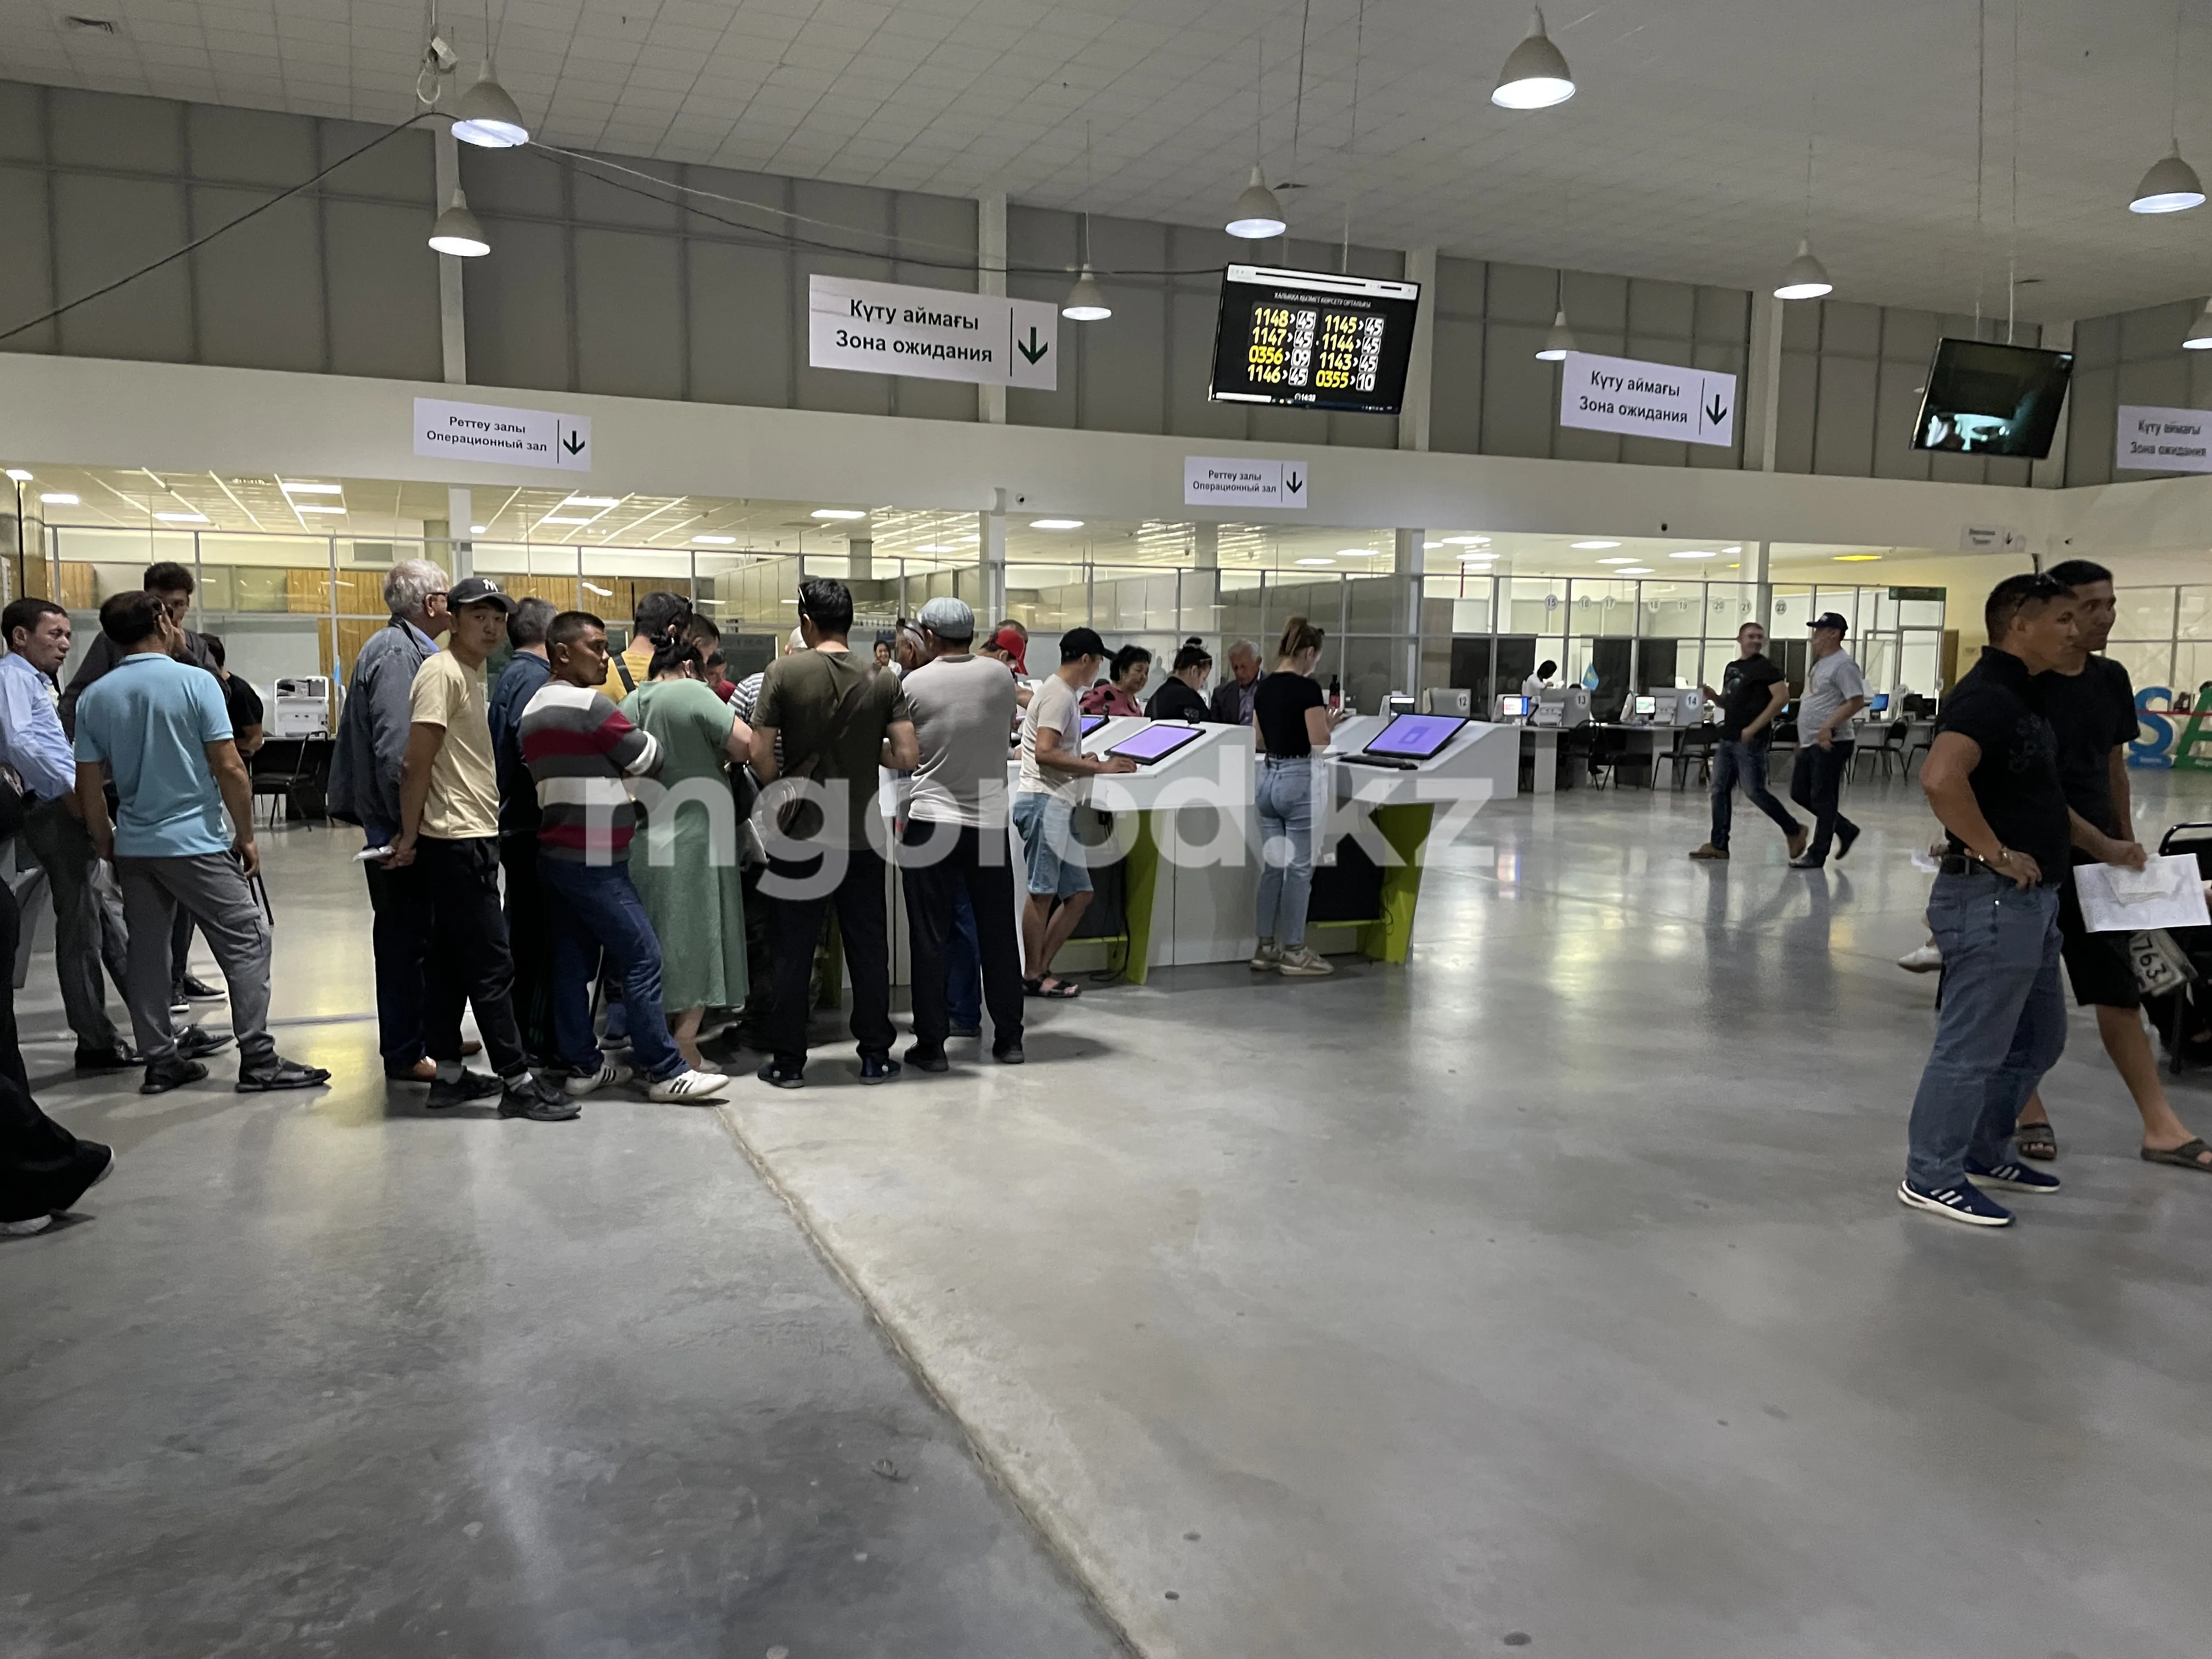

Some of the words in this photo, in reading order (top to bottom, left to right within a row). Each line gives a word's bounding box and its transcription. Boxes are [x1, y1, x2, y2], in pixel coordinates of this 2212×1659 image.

[850, 299, 896, 325] Күту
[903, 307, 978, 330] аймағы
[1255, 307, 1289, 328] 1148
[1297, 311, 1314, 329] 45
[1325, 314, 1357, 334] 1145
[1365, 318, 1383, 335] 45
[836, 330, 886, 351] Зона
[893, 340, 992, 363] ожидания
[1252, 326, 1287, 346] 1147
[1295, 330, 1312, 348] 45
[1322, 333, 1354, 352] 1144
[1363, 336, 1379, 353] 45
[1249, 345, 1283, 365] 0356
[1293, 349, 1309, 366] 09
[1319, 352, 1352, 370] 1143
[1361, 355, 1376, 372] 45
[1248, 364, 1280, 383] 1146
[1290, 368, 1306, 385] 45
[1316, 370, 1349, 388] 0355
[1358, 373, 1374, 390] 10
[1591, 370, 1623, 392] Күту
[1627, 377, 1679, 397] аймағы
[1579, 396, 1614, 413] Зона
[1619, 404, 1688, 423] ожидания
[449, 416, 490, 431] Реттеу
[494, 423, 525, 433] залы
[427, 430, 522, 449] Операционный
[527, 442, 547, 452] зал
[1209, 470, 1237, 482] Реттеу
[1239, 473, 1261, 481] залы
[1193, 481, 1259, 493] Операционный
[1548, 598, 1556, 606] 15
[1606, 599, 1614, 607] 17
[1459, 696, 1466, 706] 12
[1578, 695, 1585, 705] 13
[1688, 696, 1697, 706] 14
[2132, 936, 2166, 979] 763
